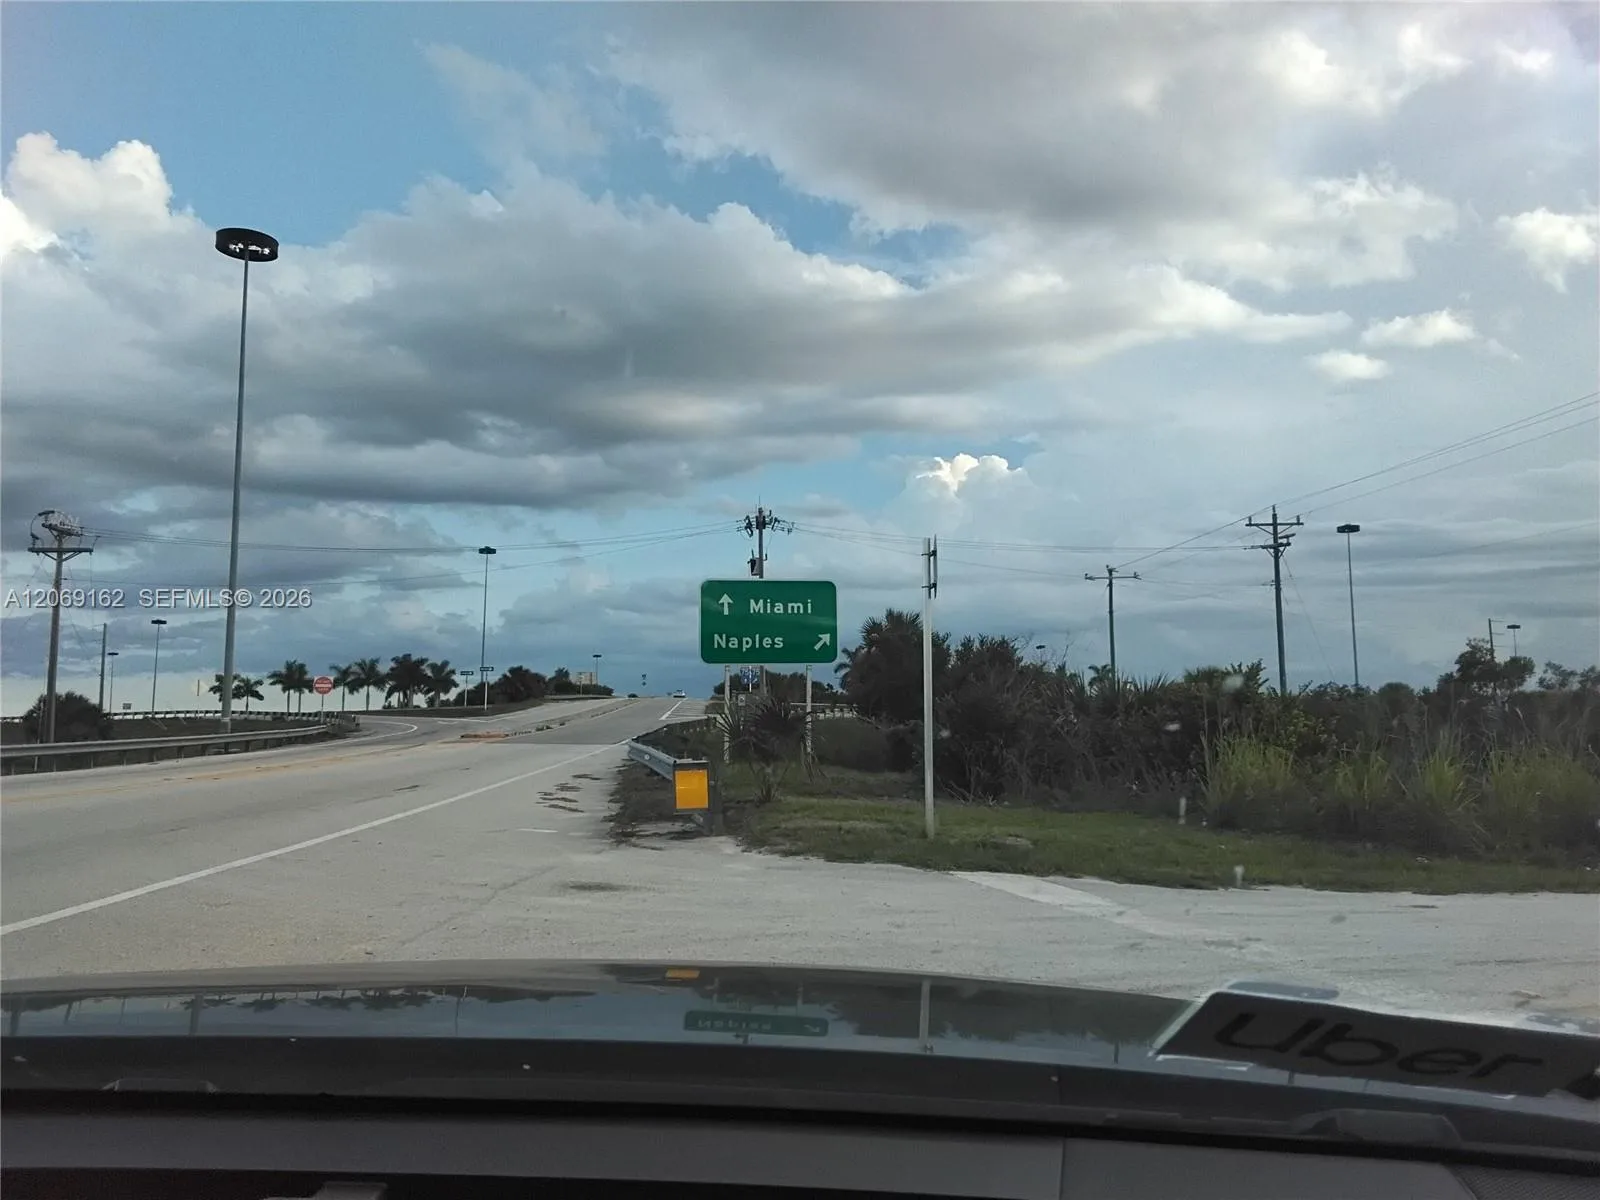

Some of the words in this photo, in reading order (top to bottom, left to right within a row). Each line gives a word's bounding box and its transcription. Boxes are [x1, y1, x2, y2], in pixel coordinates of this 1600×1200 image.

[749, 599, 813, 614] Miami
[713, 633, 784, 652] Naples
[1214, 1012, 1544, 1078] Uber
